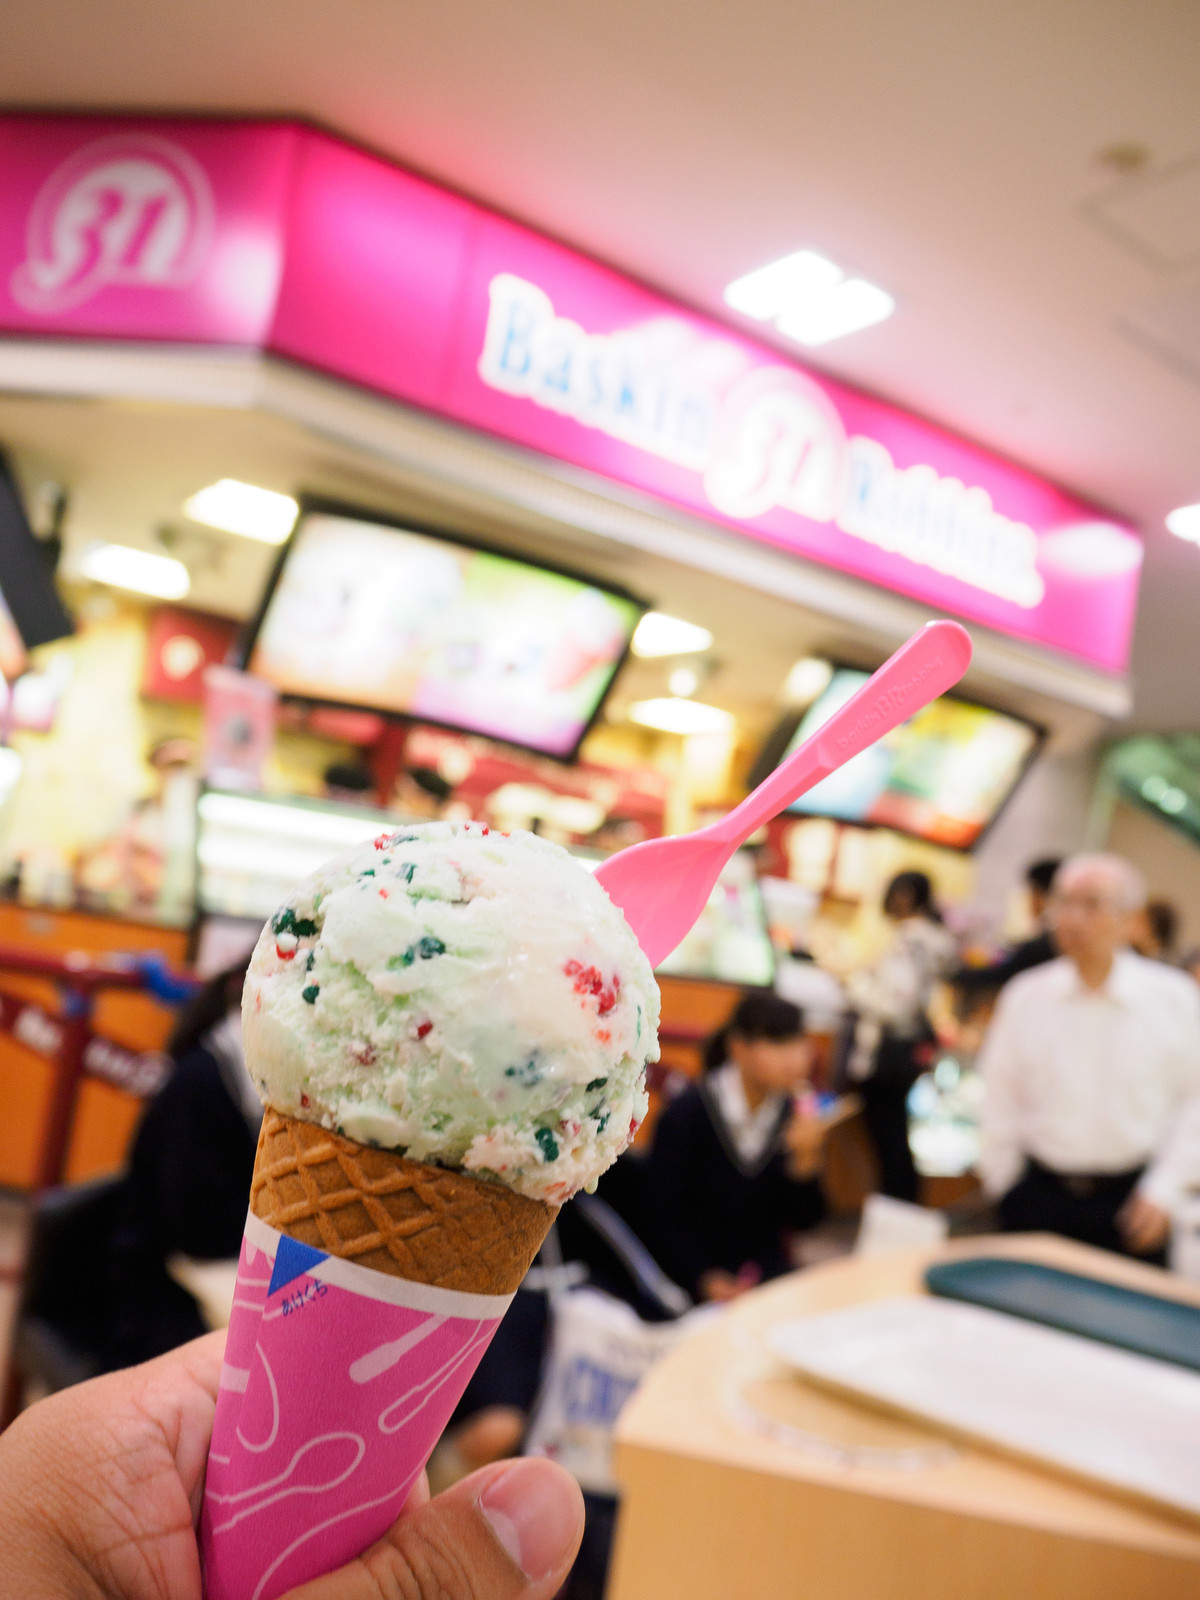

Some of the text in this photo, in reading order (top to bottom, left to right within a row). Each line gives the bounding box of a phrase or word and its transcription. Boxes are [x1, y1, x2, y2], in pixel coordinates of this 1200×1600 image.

[486, 284, 716, 458] Baskin
[281, 1278, 329, 1317] あけくち
